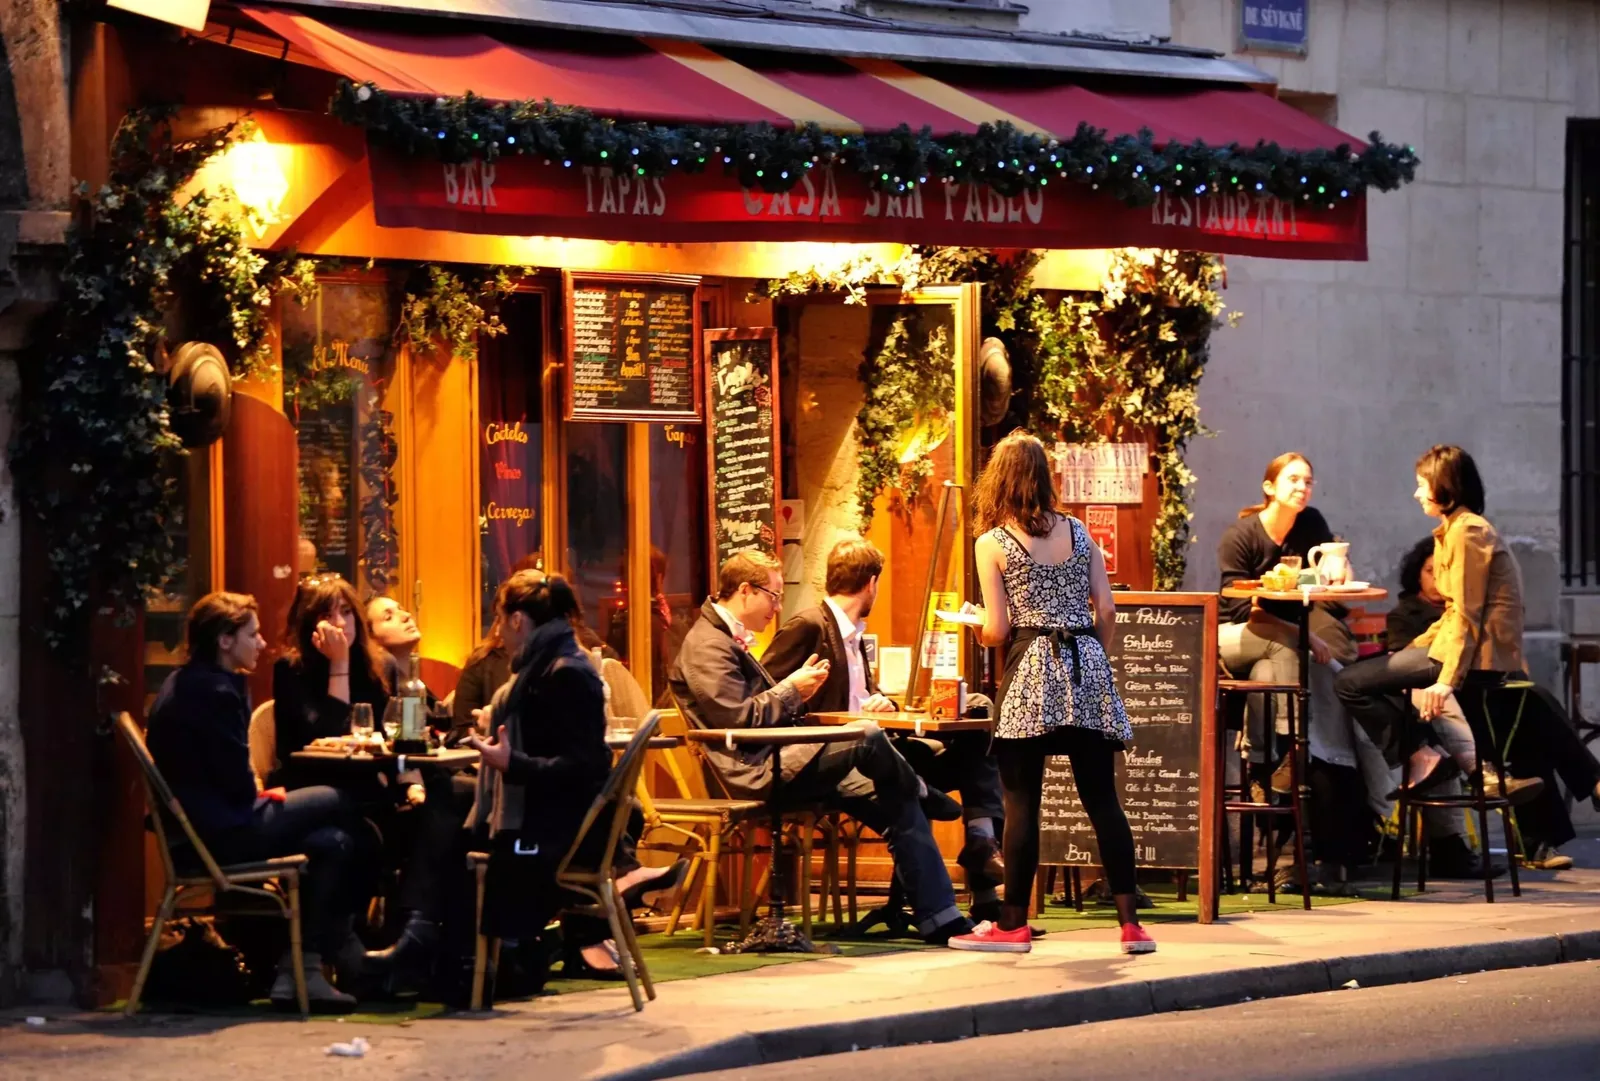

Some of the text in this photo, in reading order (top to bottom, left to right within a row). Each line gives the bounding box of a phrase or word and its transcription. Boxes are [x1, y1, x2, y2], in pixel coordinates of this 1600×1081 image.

[1244, 6, 1259, 26] DE
[583, 166, 667, 216] TAPAS
[1064, 843, 1094, 865] Bon
